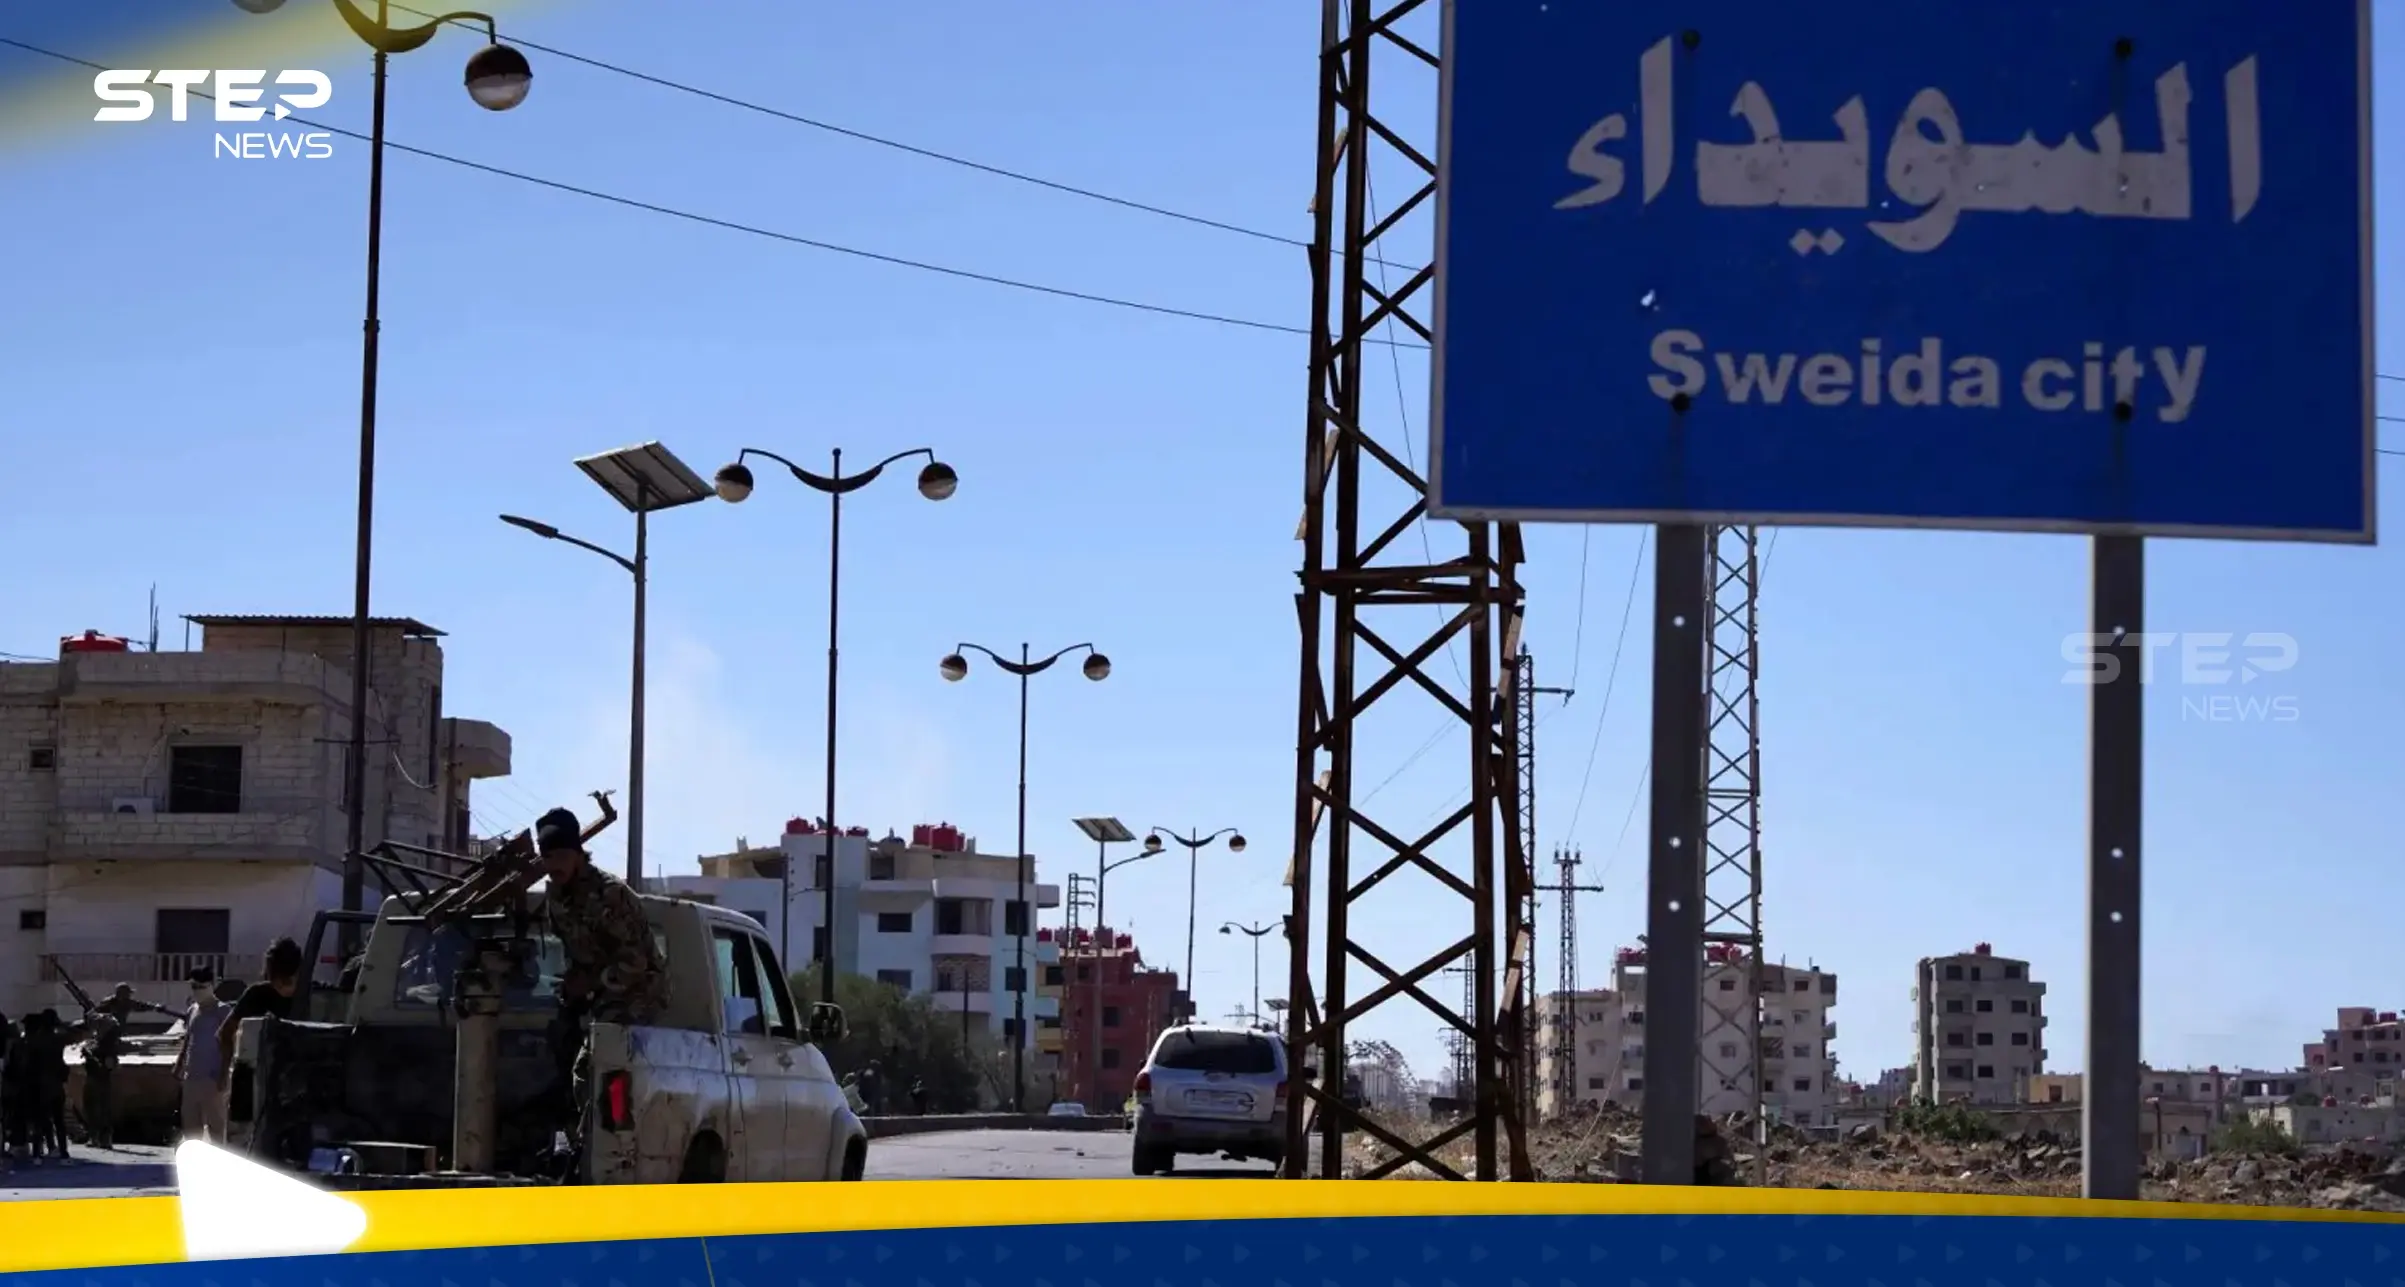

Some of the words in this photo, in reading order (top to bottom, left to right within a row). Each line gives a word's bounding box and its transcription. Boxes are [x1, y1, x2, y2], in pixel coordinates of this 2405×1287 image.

[1553, 35, 2261, 255] السويداء
[1647, 329, 2001, 408] Sweida
[2021, 342, 2207, 423] city
